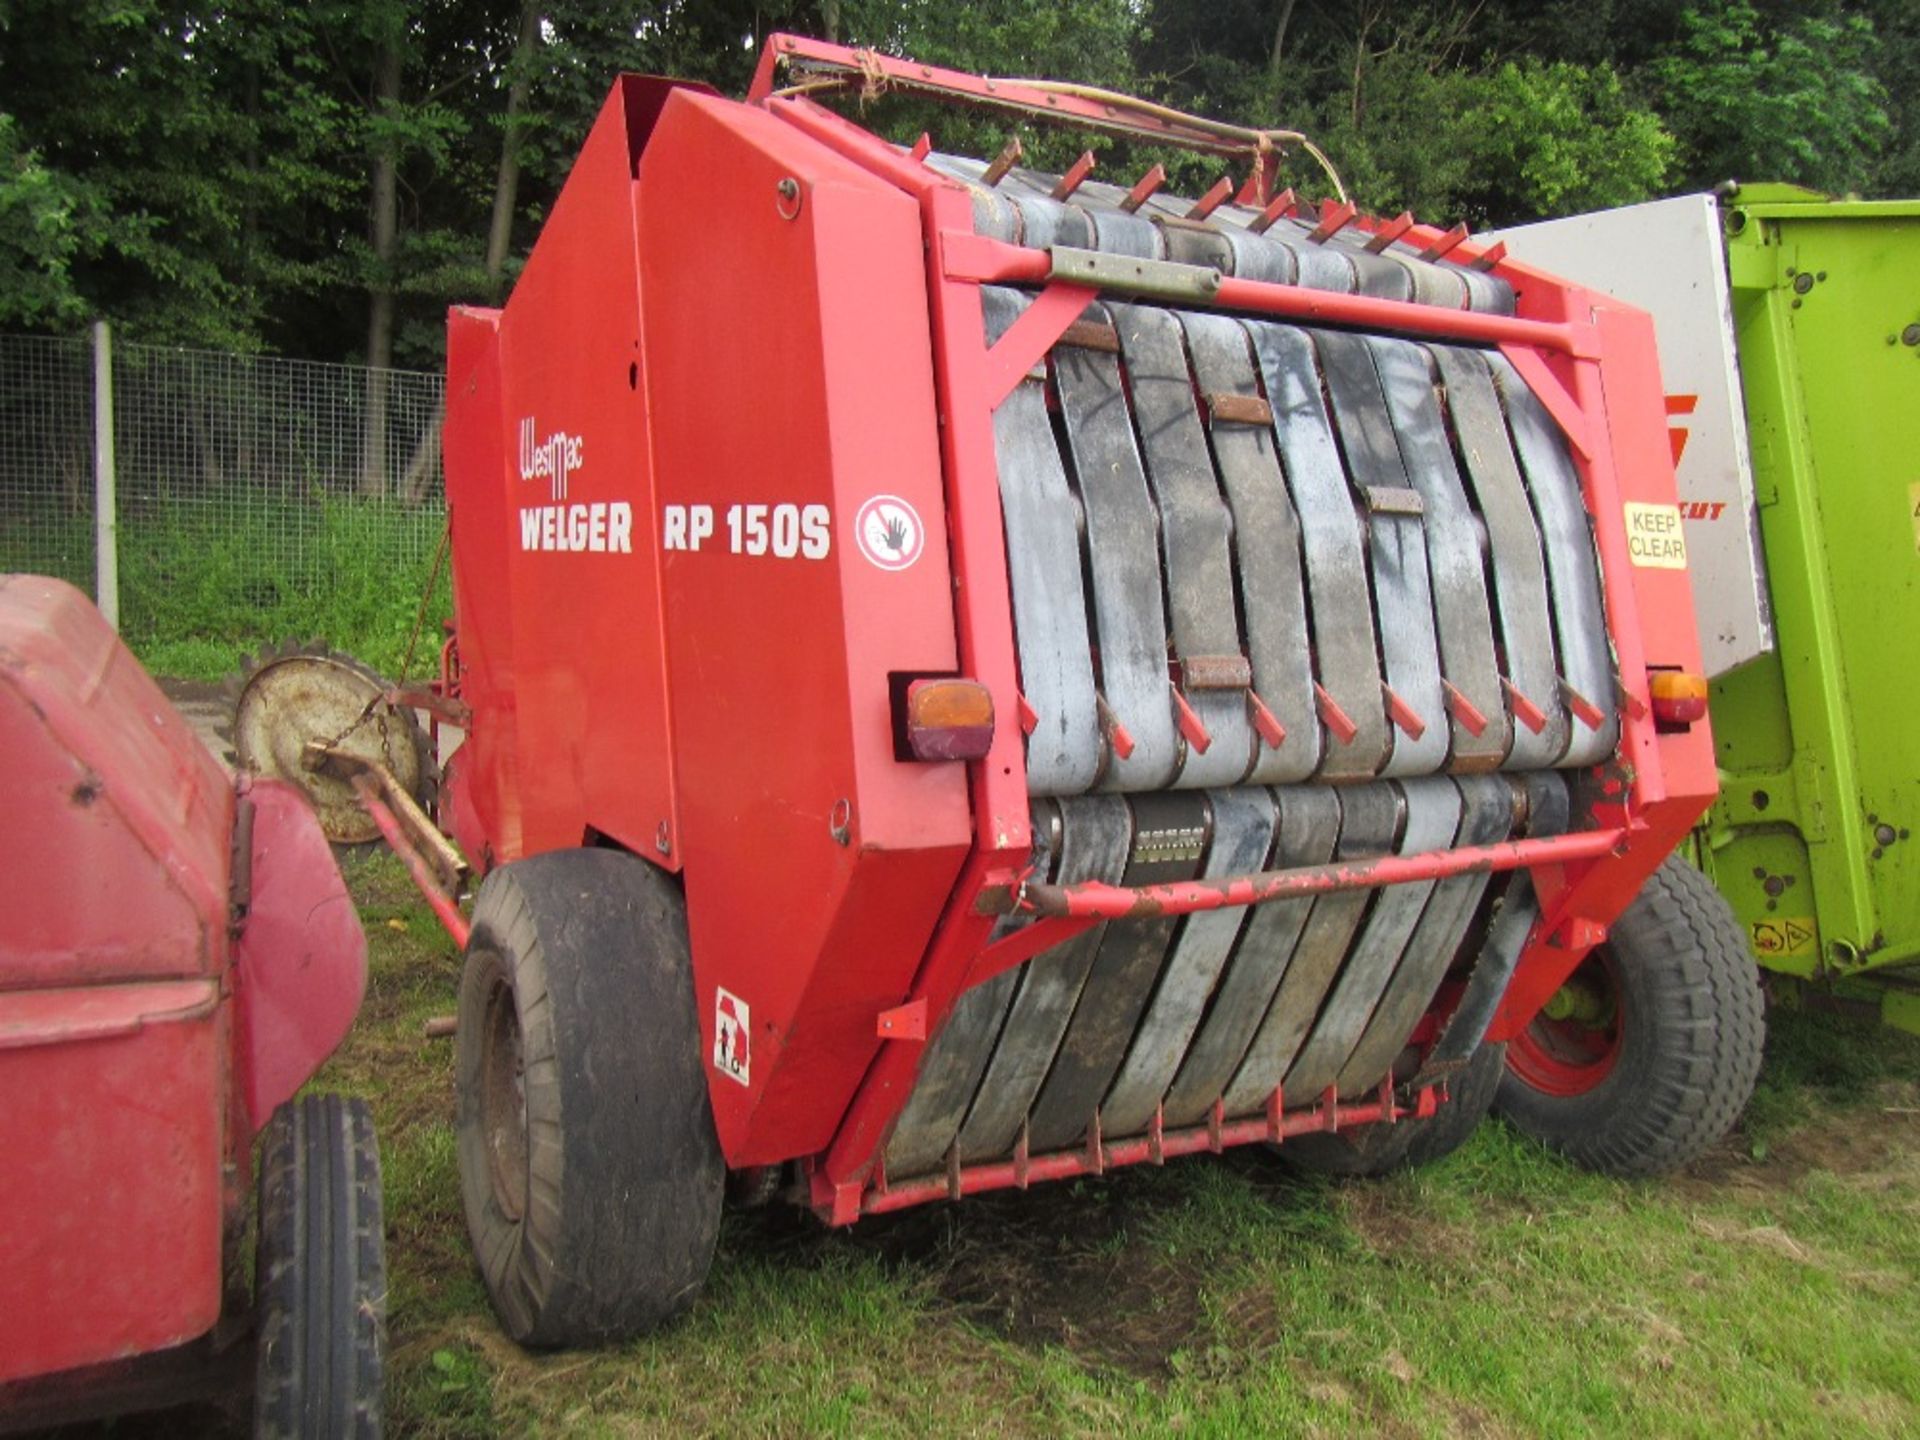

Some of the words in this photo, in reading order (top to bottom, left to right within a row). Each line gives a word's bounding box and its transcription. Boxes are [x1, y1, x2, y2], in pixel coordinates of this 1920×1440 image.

[520, 502, 632, 553] WELGER
[664, 504, 713, 551] RP
[727, 504, 831, 560] 150S
[1633, 512, 1676, 533] KEEP
[1630, 536, 1685, 558] CLEAR
